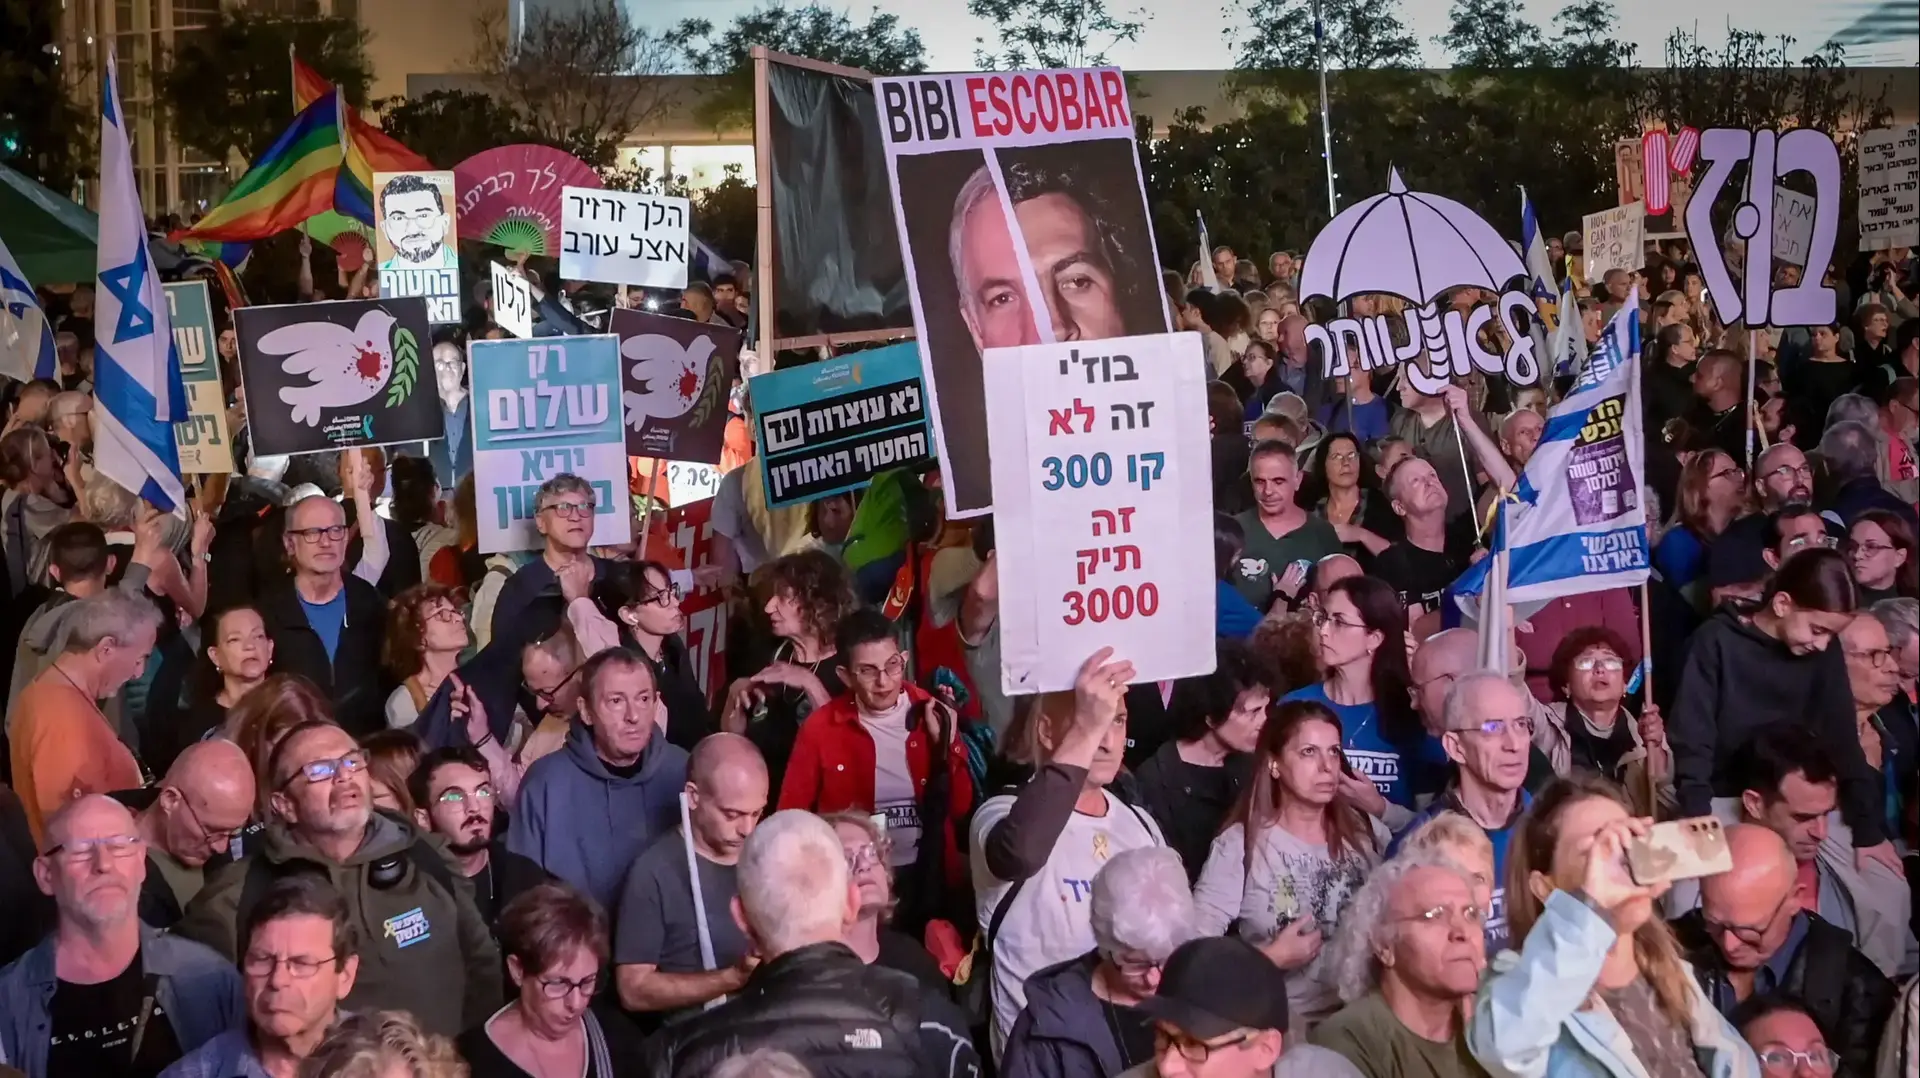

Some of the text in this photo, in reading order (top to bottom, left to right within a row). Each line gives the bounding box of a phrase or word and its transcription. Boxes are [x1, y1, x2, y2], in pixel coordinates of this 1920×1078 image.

[882, 71, 1129, 143] BIBI ESCOBAR
[526, 161, 557, 195] לך
[569, 196, 683, 231] הלך זרזיר
[1590, 208, 1628, 229] HOW LOW
[563, 231, 685, 263] אצל עורב
[1590, 224, 1623, 245] CAN YOU
[381, 269, 459, 298] החטוף
[495, 272, 526, 322] קלון
[426, 296, 460, 322] הא
[527, 344, 567, 379] רק
[1059, 349, 1139, 384] בוז'י
[488, 380, 608, 431] שלום
[767, 385, 920, 444] לא עוצרות עד
[1048, 398, 1155, 436] זה לא
[771, 432, 926, 498] החטוף האחרון
[1042, 452, 1165, 491] קו 300
[1091, 506, 1136, 536] זה
[1580, 530, 1640, 555] חופשי
[1581, 548, 1645, 572] בארצנו
[1076, 545, 1141, 584] תיק
[1062, 582, 1159, 626] 3000
